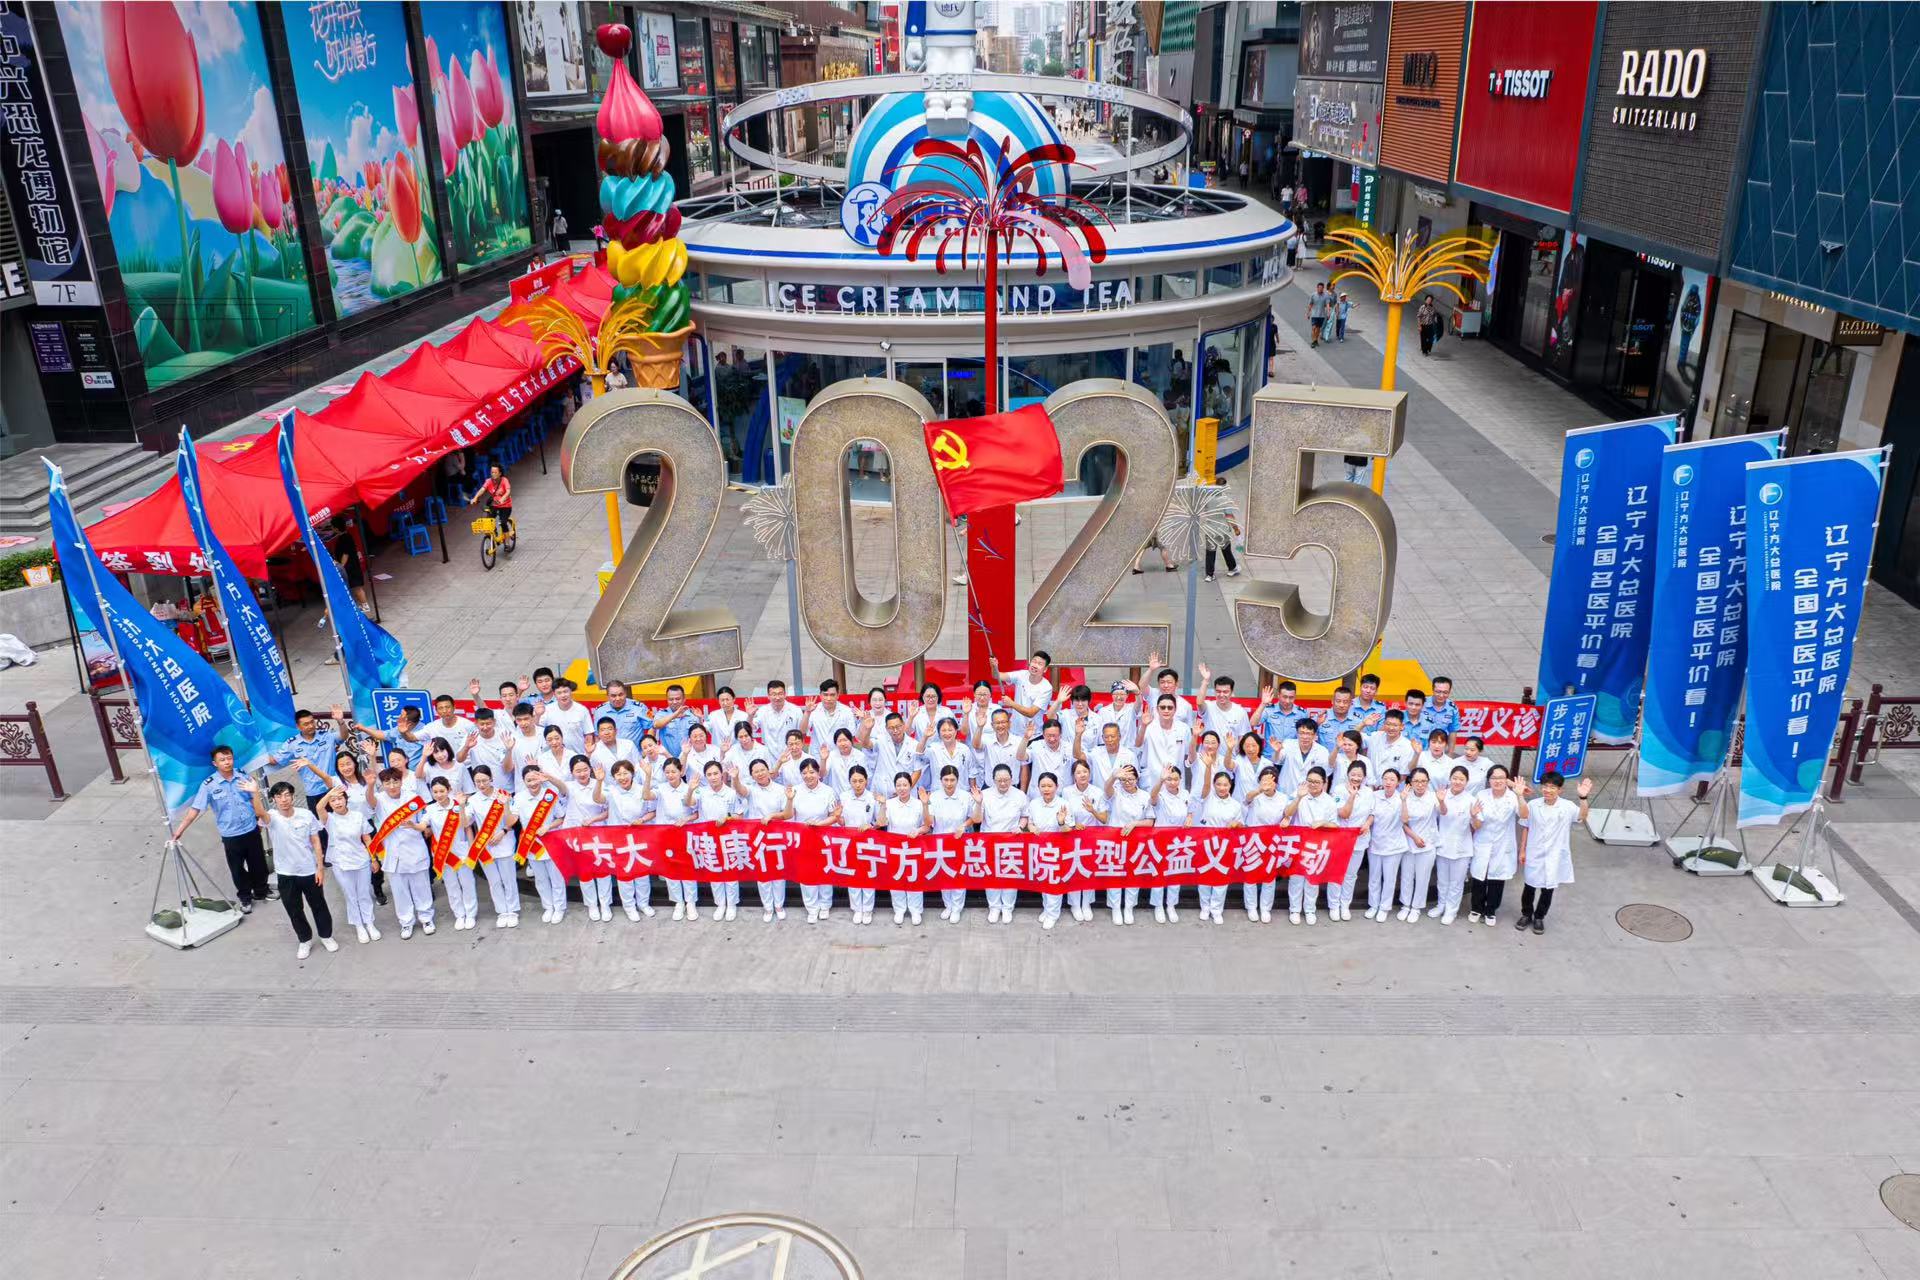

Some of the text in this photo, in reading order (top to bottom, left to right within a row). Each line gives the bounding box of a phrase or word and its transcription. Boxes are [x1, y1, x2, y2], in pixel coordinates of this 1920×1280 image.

[921, 74, 973, 90] DESHI
[1503, 69, 1551, 98] TISSOT
[1616, 48, 1708, 99] RADO
[1612, 106, 1697, 131] SWITZERLAND
[51, 284, 77, 303] 7F
[768, 283, 817, 308] ICE
[836, 286, 960, 310] CREAM
[996, 285, 1056, 310] ND
[1610, 485, 1648, 640] 辽宁方大总医院
[1716, 505, 1747, 669] 辽宁方大总医院
[1576, 525, 1618, 688] 全国名医平价看！
[1816, 524, 1850, 695] 辽宁方大总医院
[1683, 546, 1722, 729] 全国名医平价看！
[1785, 567, 1819, 759] 全国名医平价看！
[113, 618, 197, 735] FANGDA GENERAL HOSPITAL
[261, 653, 283, 695] HOSPITAL
[1458, 707, 1541, 741] 型义诊
[1545, 703, 1569, 760] 步行街
[1567, 702, 1590, 756] 一切车辆
[821, 833, 1331, 886] 辽宁方大总医院大型公益义诊活动
